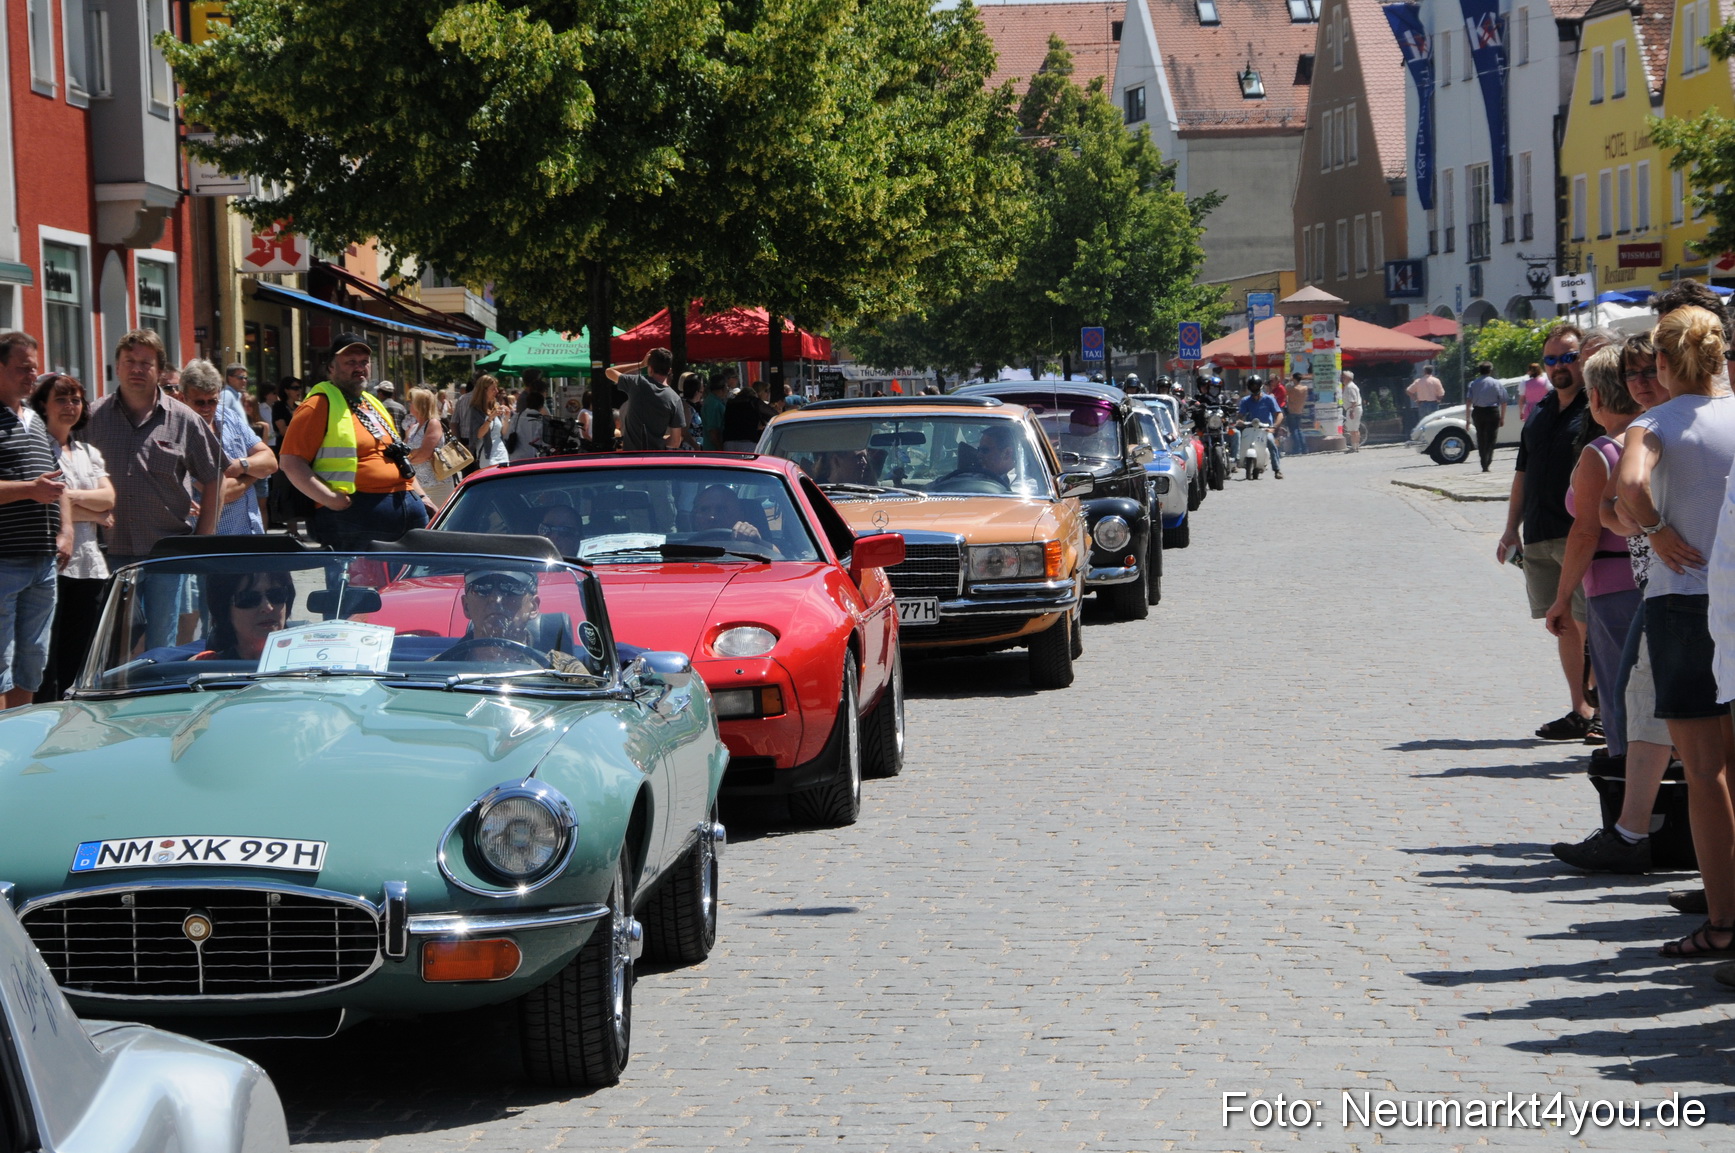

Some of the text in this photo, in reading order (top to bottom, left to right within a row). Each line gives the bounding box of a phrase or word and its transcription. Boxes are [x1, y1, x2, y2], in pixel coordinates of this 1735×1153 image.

[1605, 131, 1628, 160] HOTEL
[1560, 279, 1587, 288] Block
[1084, 350, 1102, 359] TAXI
[1181, 348, 1201, 358] TAXI
[97, 840, 154, 865] NM
[176, 839, 231, 861] XK
[80, 859, 89, 867] D
